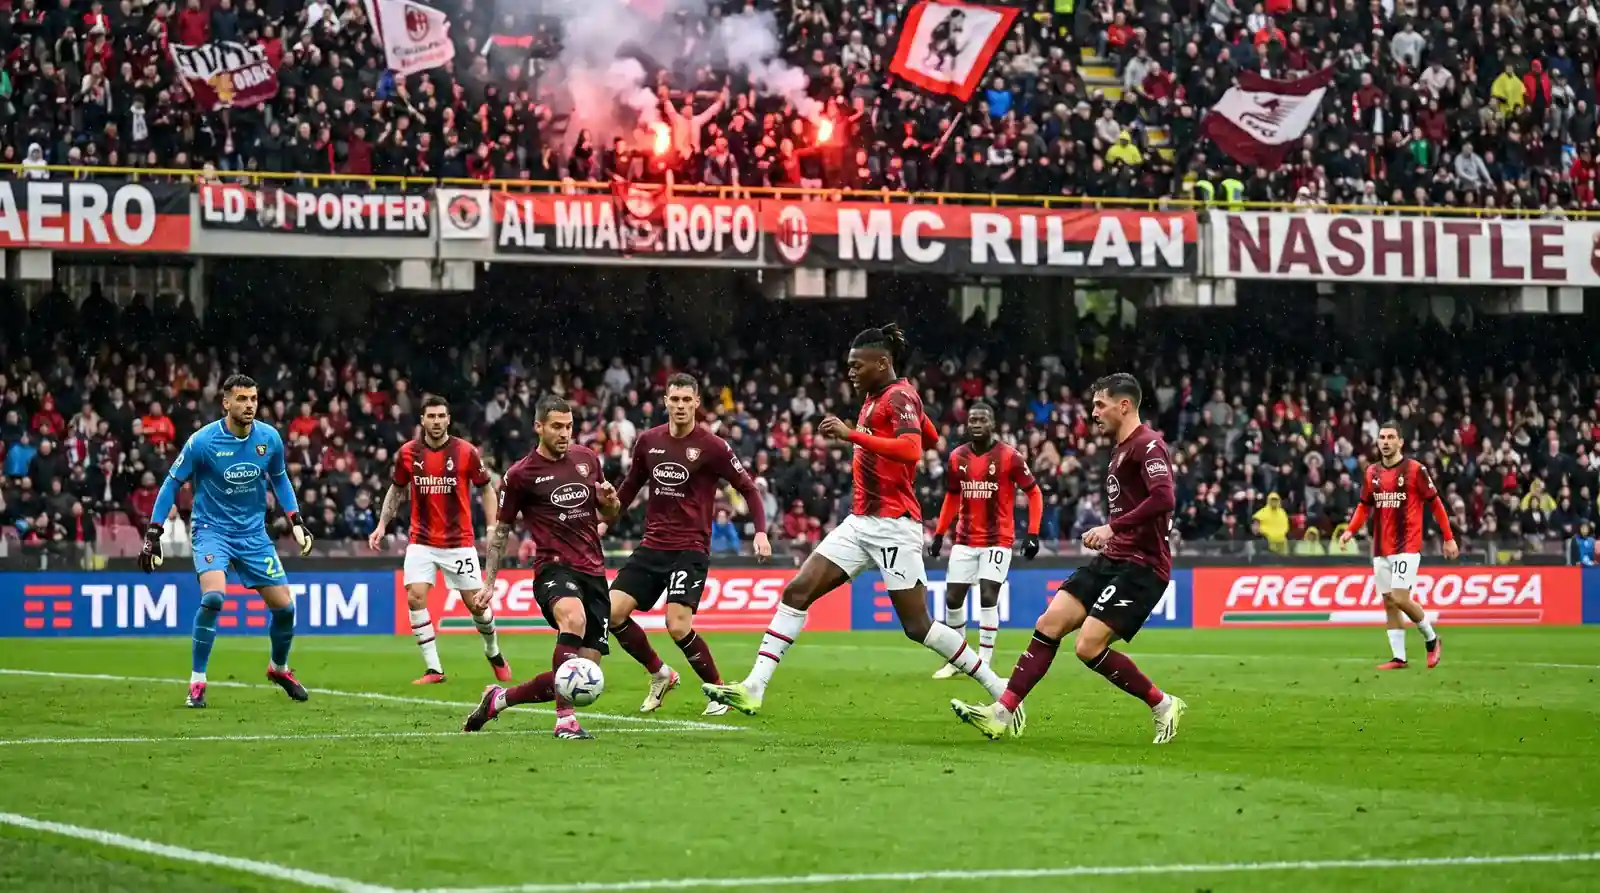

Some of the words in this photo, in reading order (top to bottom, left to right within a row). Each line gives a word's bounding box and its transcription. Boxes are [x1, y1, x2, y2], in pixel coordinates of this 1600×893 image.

[0, 181, 156, 246] AERO
[296, 191, 428, 231] PORTER
[498, 199, 546, 247] AL
[666, 204, 756, 254] ROFO
[836, 208, 947, 264] MC
[969, 211, 1186, 268] RILAN
[1226, 214, 1568, 281] NASHITLE
[413, 474, 458, 486] Emirates
[455, 557, 474, 576] 25
[880, 546, 899, 569] 17
[988, 549, 1004, 565] 10
[1392, 560, 1408, 575] 10
[669, 570, 688, 590] 12
[1097, 584, 1117, 604] 9
[81, 583, 178, 629] TIM
